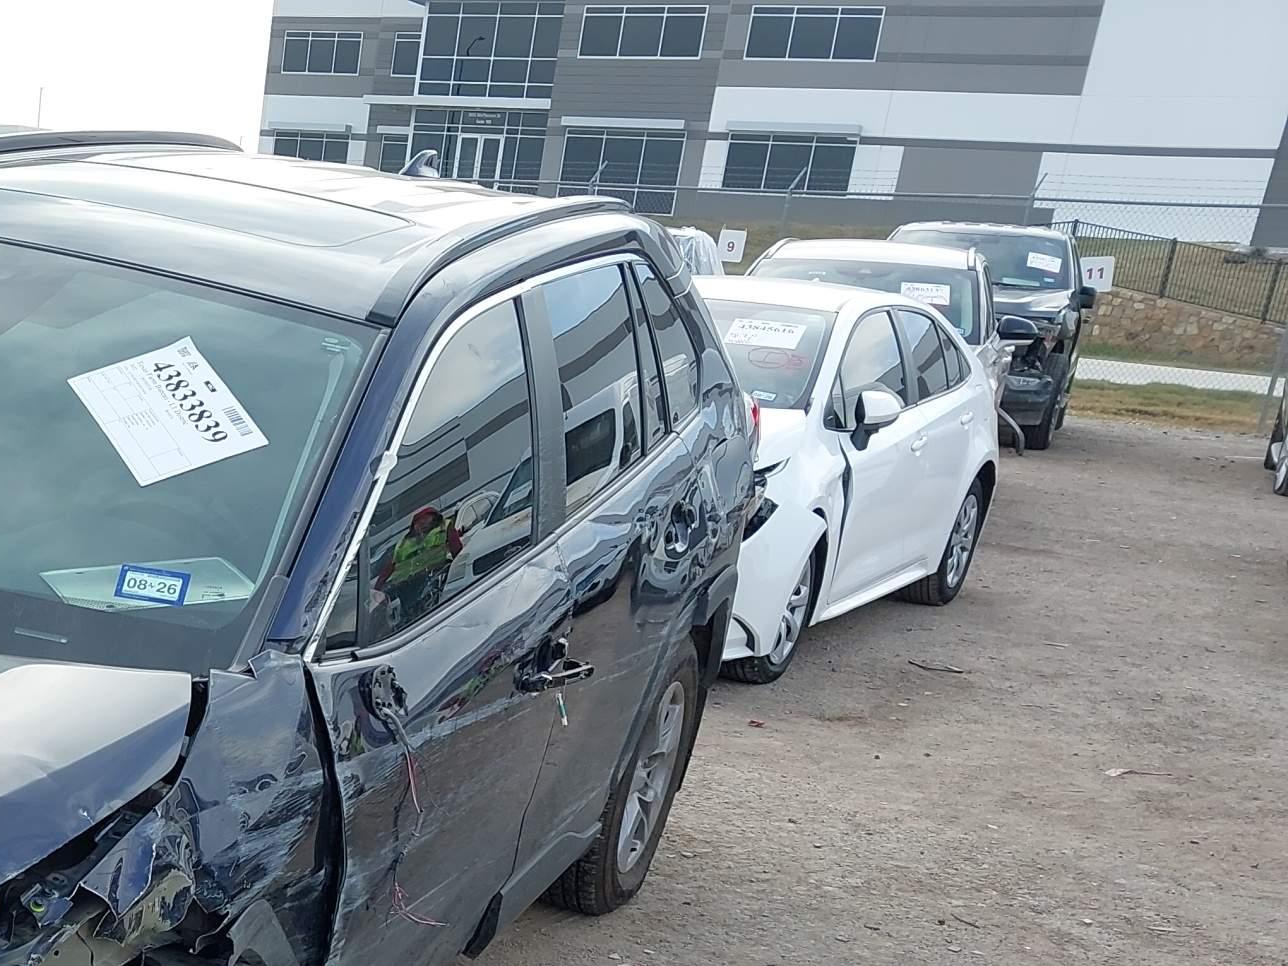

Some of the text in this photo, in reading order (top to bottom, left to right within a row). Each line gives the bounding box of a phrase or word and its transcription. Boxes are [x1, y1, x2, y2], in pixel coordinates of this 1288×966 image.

[727, 241, 735, 252] 9
[1087, 266, 1104, 280] 11
[152, 361, 229, 443] 43833839
[127, 577, 178, 595] 08 26
